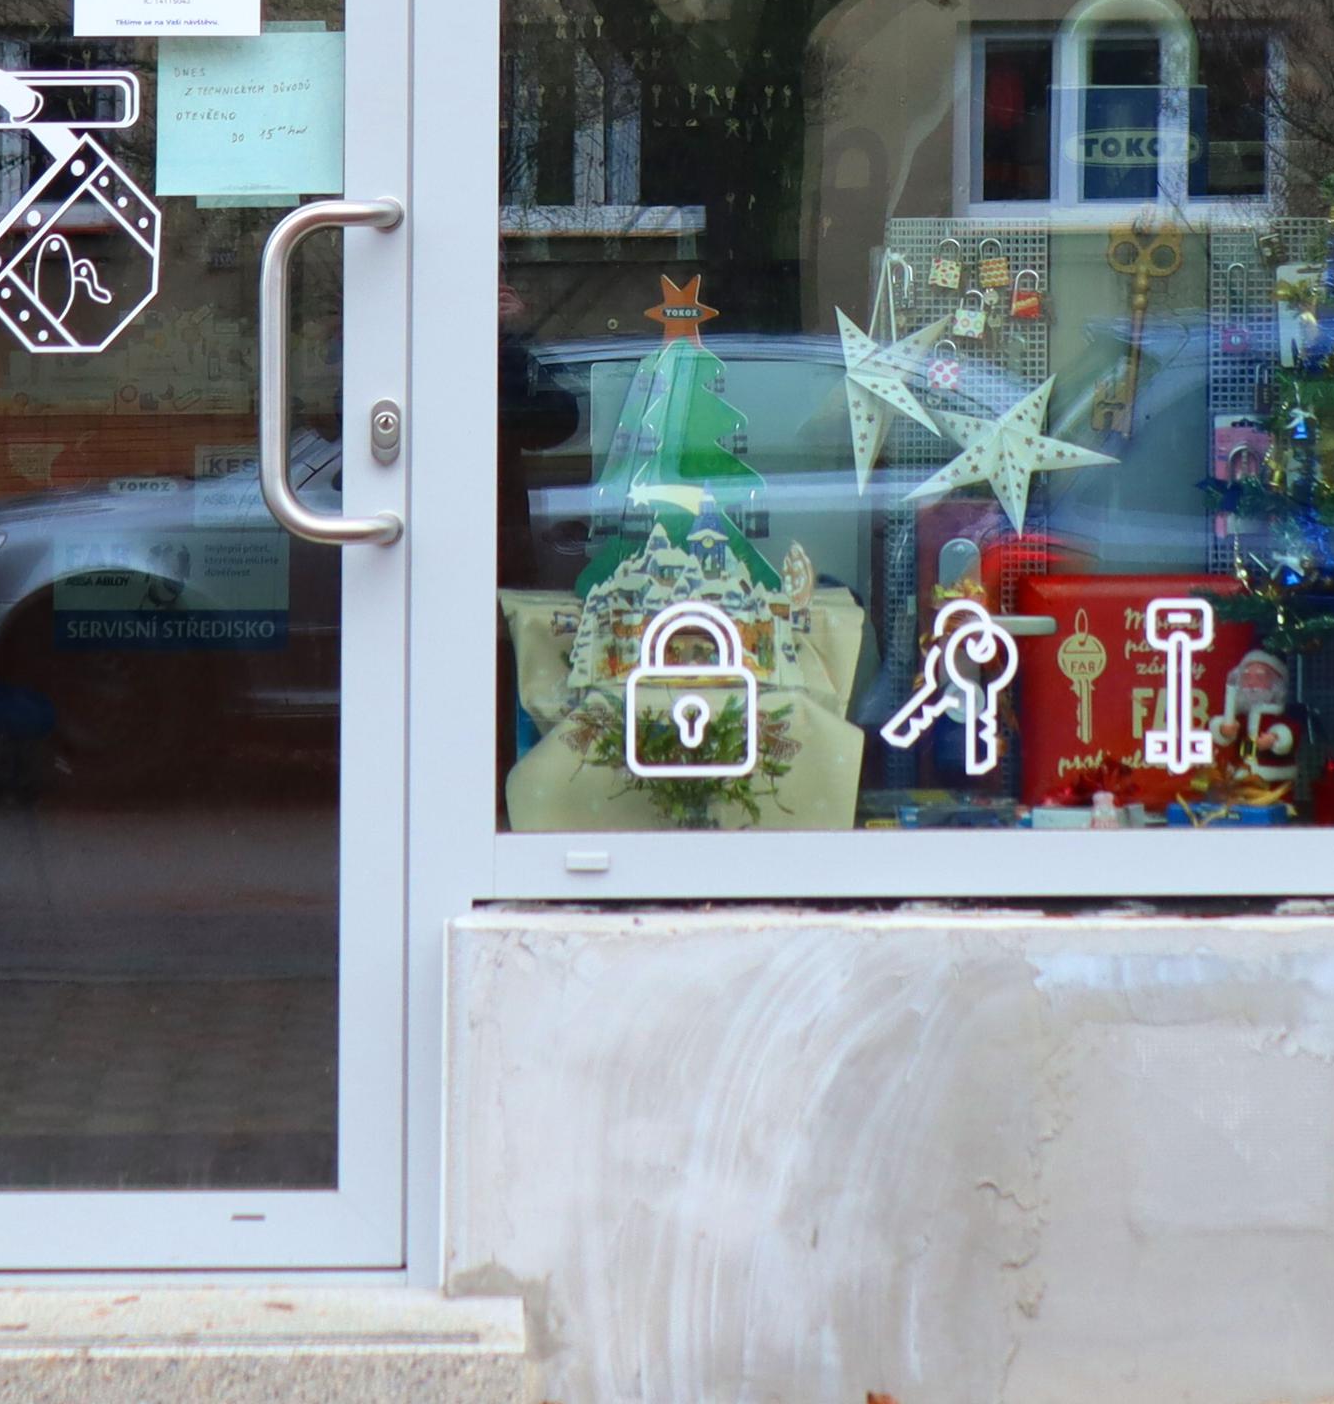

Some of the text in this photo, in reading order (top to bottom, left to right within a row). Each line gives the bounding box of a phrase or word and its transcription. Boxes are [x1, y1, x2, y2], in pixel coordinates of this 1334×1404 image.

[174, 67, 206, 77] DNES
[184, 87, 194, 96] Z
[176, 108, 236, 121] OTEVŘENO
[231, 132, 245, 143] DO
[67, 616, 275, 638] SERVISNÍ STŘEDISKO
